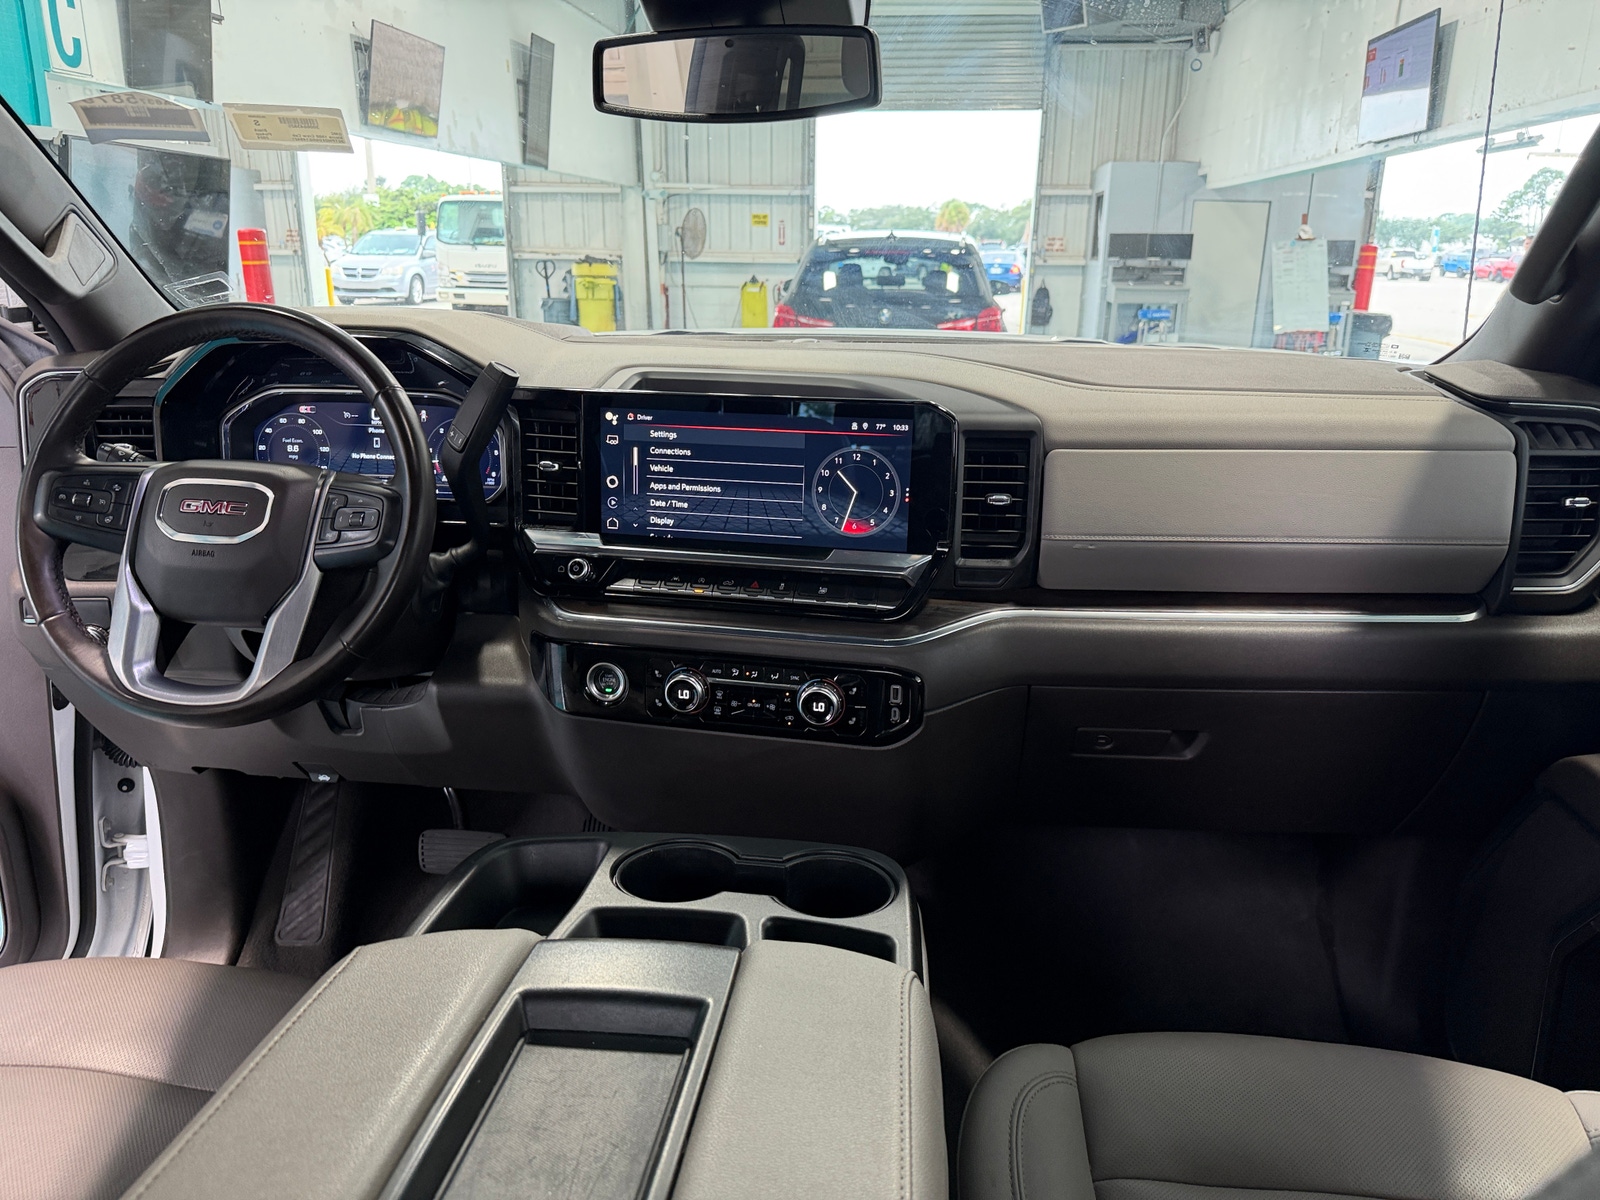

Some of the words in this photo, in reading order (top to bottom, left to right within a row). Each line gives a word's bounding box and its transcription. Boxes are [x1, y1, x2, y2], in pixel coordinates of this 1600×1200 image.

[636, 413, 653, 421] Driver
[649, 430, 678, 440] Settings
[649, 446, 692, 456] Connections
[852, 453, 861, 461] 12
[649, 464, 674, 473] Vehicle
[820, 469, 830, 477] 10
[885, 472, 890, 480] 2
[649, 482, 667, 490] Apps
[681, 483, 722, 493] Permissions
[889, 489, 895, 497] 3
[180, 499, 249, 516] GMC
[650, 499, 666, 507] Date
[671, 500, 689, 508] Time
[821, 503, 827, 511] 8
[882, 506, 888, 514] 4
[649, 516, 675, 526] Display
[869, 518, 875, 526] 5
[851, 522, 857, 530] 6
[191, 549, 215, 558] AIRBAG
